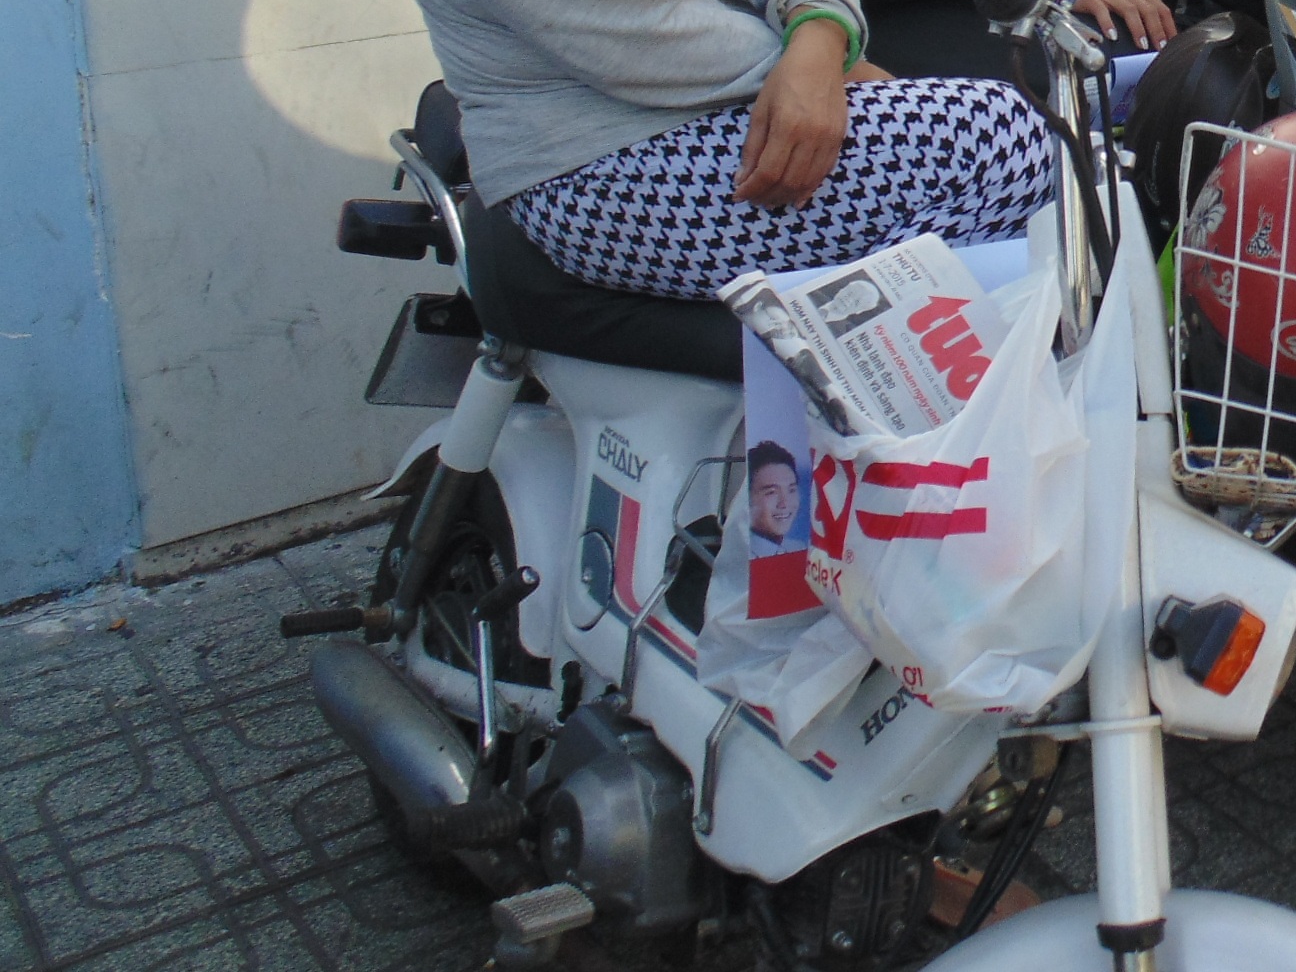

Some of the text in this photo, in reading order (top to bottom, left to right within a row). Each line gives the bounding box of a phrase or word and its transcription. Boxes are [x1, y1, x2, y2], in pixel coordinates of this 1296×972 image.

[821, 348, 837, 368] SINH
[893, 354, 906, 370] 100
[926, 406, 942, 426] sinh
[598, 432, 649, 483] CHALY
